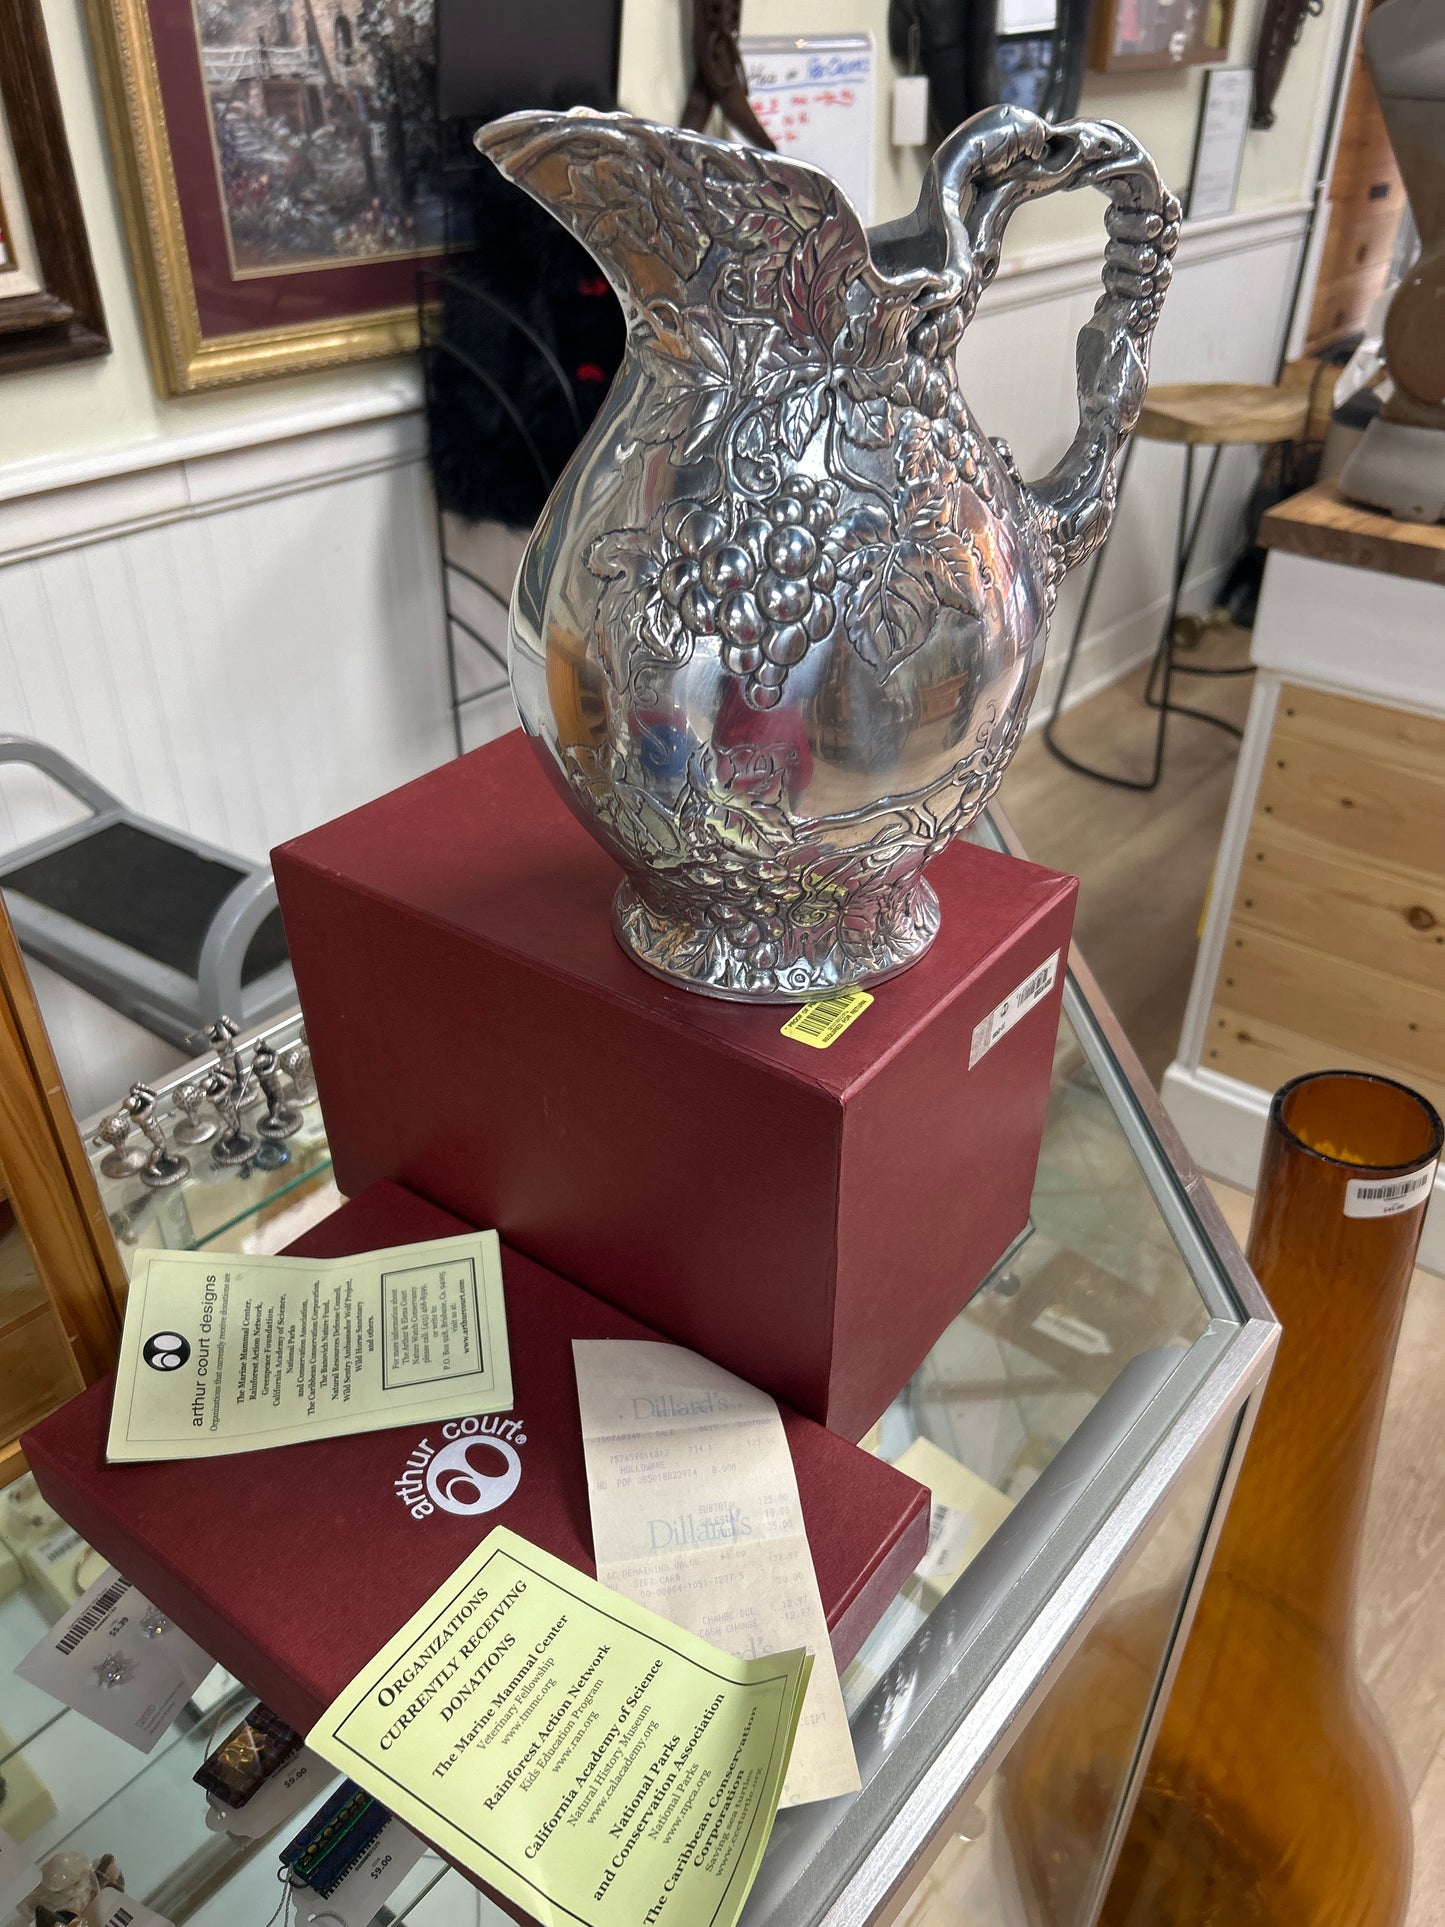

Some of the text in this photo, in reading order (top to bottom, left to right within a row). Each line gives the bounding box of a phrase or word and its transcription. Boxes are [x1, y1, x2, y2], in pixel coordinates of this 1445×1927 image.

[221, 1284, 229, 1315] donations
[321, 1319, 329, 1341] Nature
[356, 1302, 364, 1333] Sanctuary
[459, 1279, 469, 1353] www.arthurcourt.com
[192, 1275, 217, 1427] arthur court designs
[216, 1341, 225, 1370] currently
[237, 1299, 251, 1404] The Marine Mammal Center,
[250, 1302, 263, 1400] Rainforest Action Network,
[262, 1354, 271, 1395] Greenpeace
[276, 1336, 284, 1368] Academy
[286, 1346, 295, 1374] National
[298, 1339, 306, 1382] Conservation
[310, 1321, 318, 1364] Conservation
[344, 1361, 352, 1383] Sentry
[423, 1345, 431, 1363] please
[210, 1386, 221, 1431] Organizations
[214, 1371, 223, 1384] that
[273, 1370, 282, 1406] California
[308, 1365, 316, 1399] Caribbean
[632, 1391, 729, 1421] Dillard's
[394, 1438, 435, 1519] arthur
[647, 1504, 753, 1551] Dillard's
[378, 1587, 488, 1707] ORGANIZATIONS
[380, 1580, 526, 1750] CURRENTLY RECEIVING
[440, 1633, 515, 1723] DONATIONS
[432, 1615, 568, 1778] The Marine Mammal Center
[476, 1658, 554, 1749] Veterinary Fellowship
[483, 1645, 611, 1811] Rainforest Action Network
[501, 1678, 557, 1744] www.tmmc.org
[519, 1680, 603, 1792] Kids Education Program
[525, 1660, 663, 1859] California Academy of Science
[552, 1711, 599, 1772] www.ran.org
[567, 1705, 651, 1827] Natural History Museum
[284, 1767, 308, 1789] $9.00
[587, 1720, 659, 1823] www.calacademy.org
[594, 1695, 725, 1901] and Conservation Association
[609, 1735, 680, 1839] National Parks
[648, 1763, 699, 1840] National Parks
[643, 1895, 667, 1925] The
[664, 1812, 713, 1892] Caribbean
[708, 1706, 758, 1808] Conservation
[663, 1769, 711, 1843] www.npca.org
[693, 1770, 744, 1867] Corporation
[370, 1854, 392, 1880] $9.00
[705, 1831, 730, 1872] Saving
[726, 1810, 737, 1831] sea
